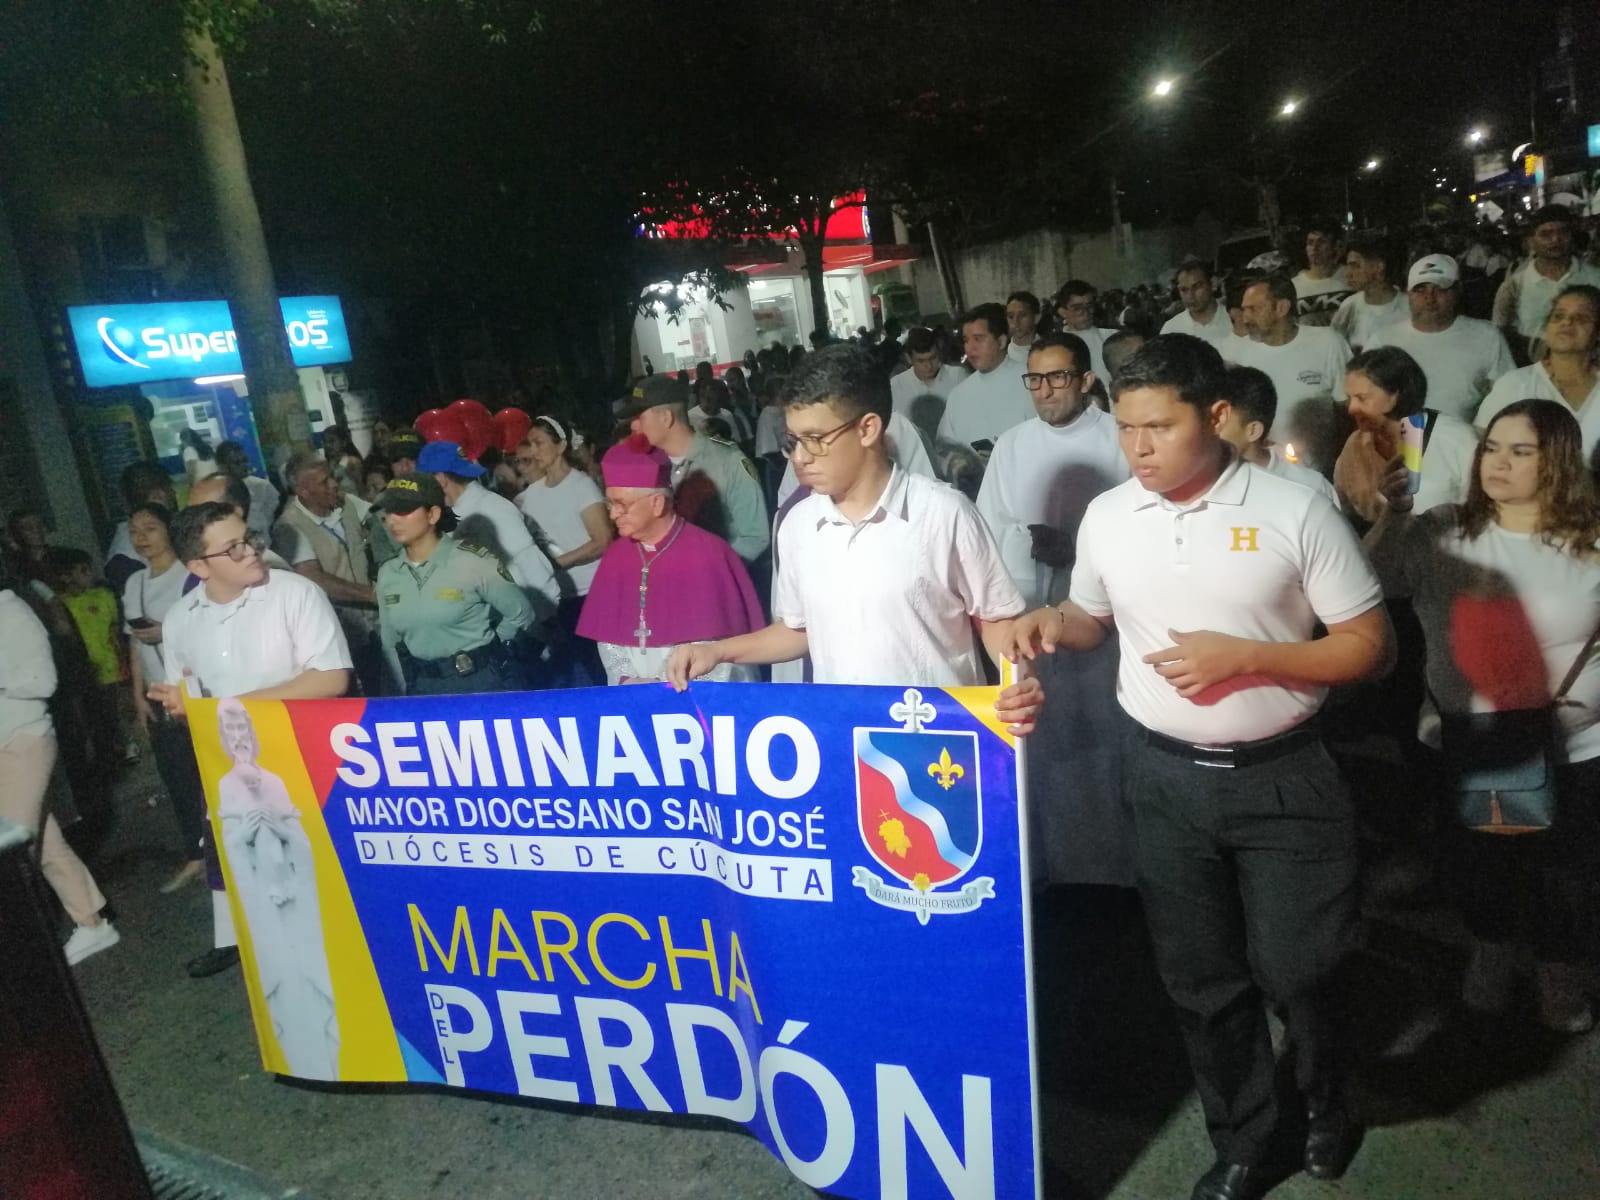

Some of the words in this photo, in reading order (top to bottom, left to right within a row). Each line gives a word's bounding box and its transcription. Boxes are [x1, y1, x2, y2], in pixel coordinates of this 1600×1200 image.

[1229, 527, 1260, 551] H
[329, 713, 822, 800] SEMINARIO
[345, 797, 449, 827] MAYOR
[457, 797, 652, 831] DIOCESANO
[664, 798, 723, 840] SAN
[731, 805, 827, 850] JOSÉ
[362, 834, 545, 867] DIÓCESIS
[576, 844, 625, 869] DE
[657, 839, 826, 896] CÚCUTA
[874, 888, 901, 903] DARÁ
[903, 896, 939, 908] MUCHO
[941, 896, 974, 909] FRUTO
[407, 903, 763, 1025] MARCHA
[430, 992, 455, 1064] DEL
[424, 983, 996, 1200] PERDÓN
